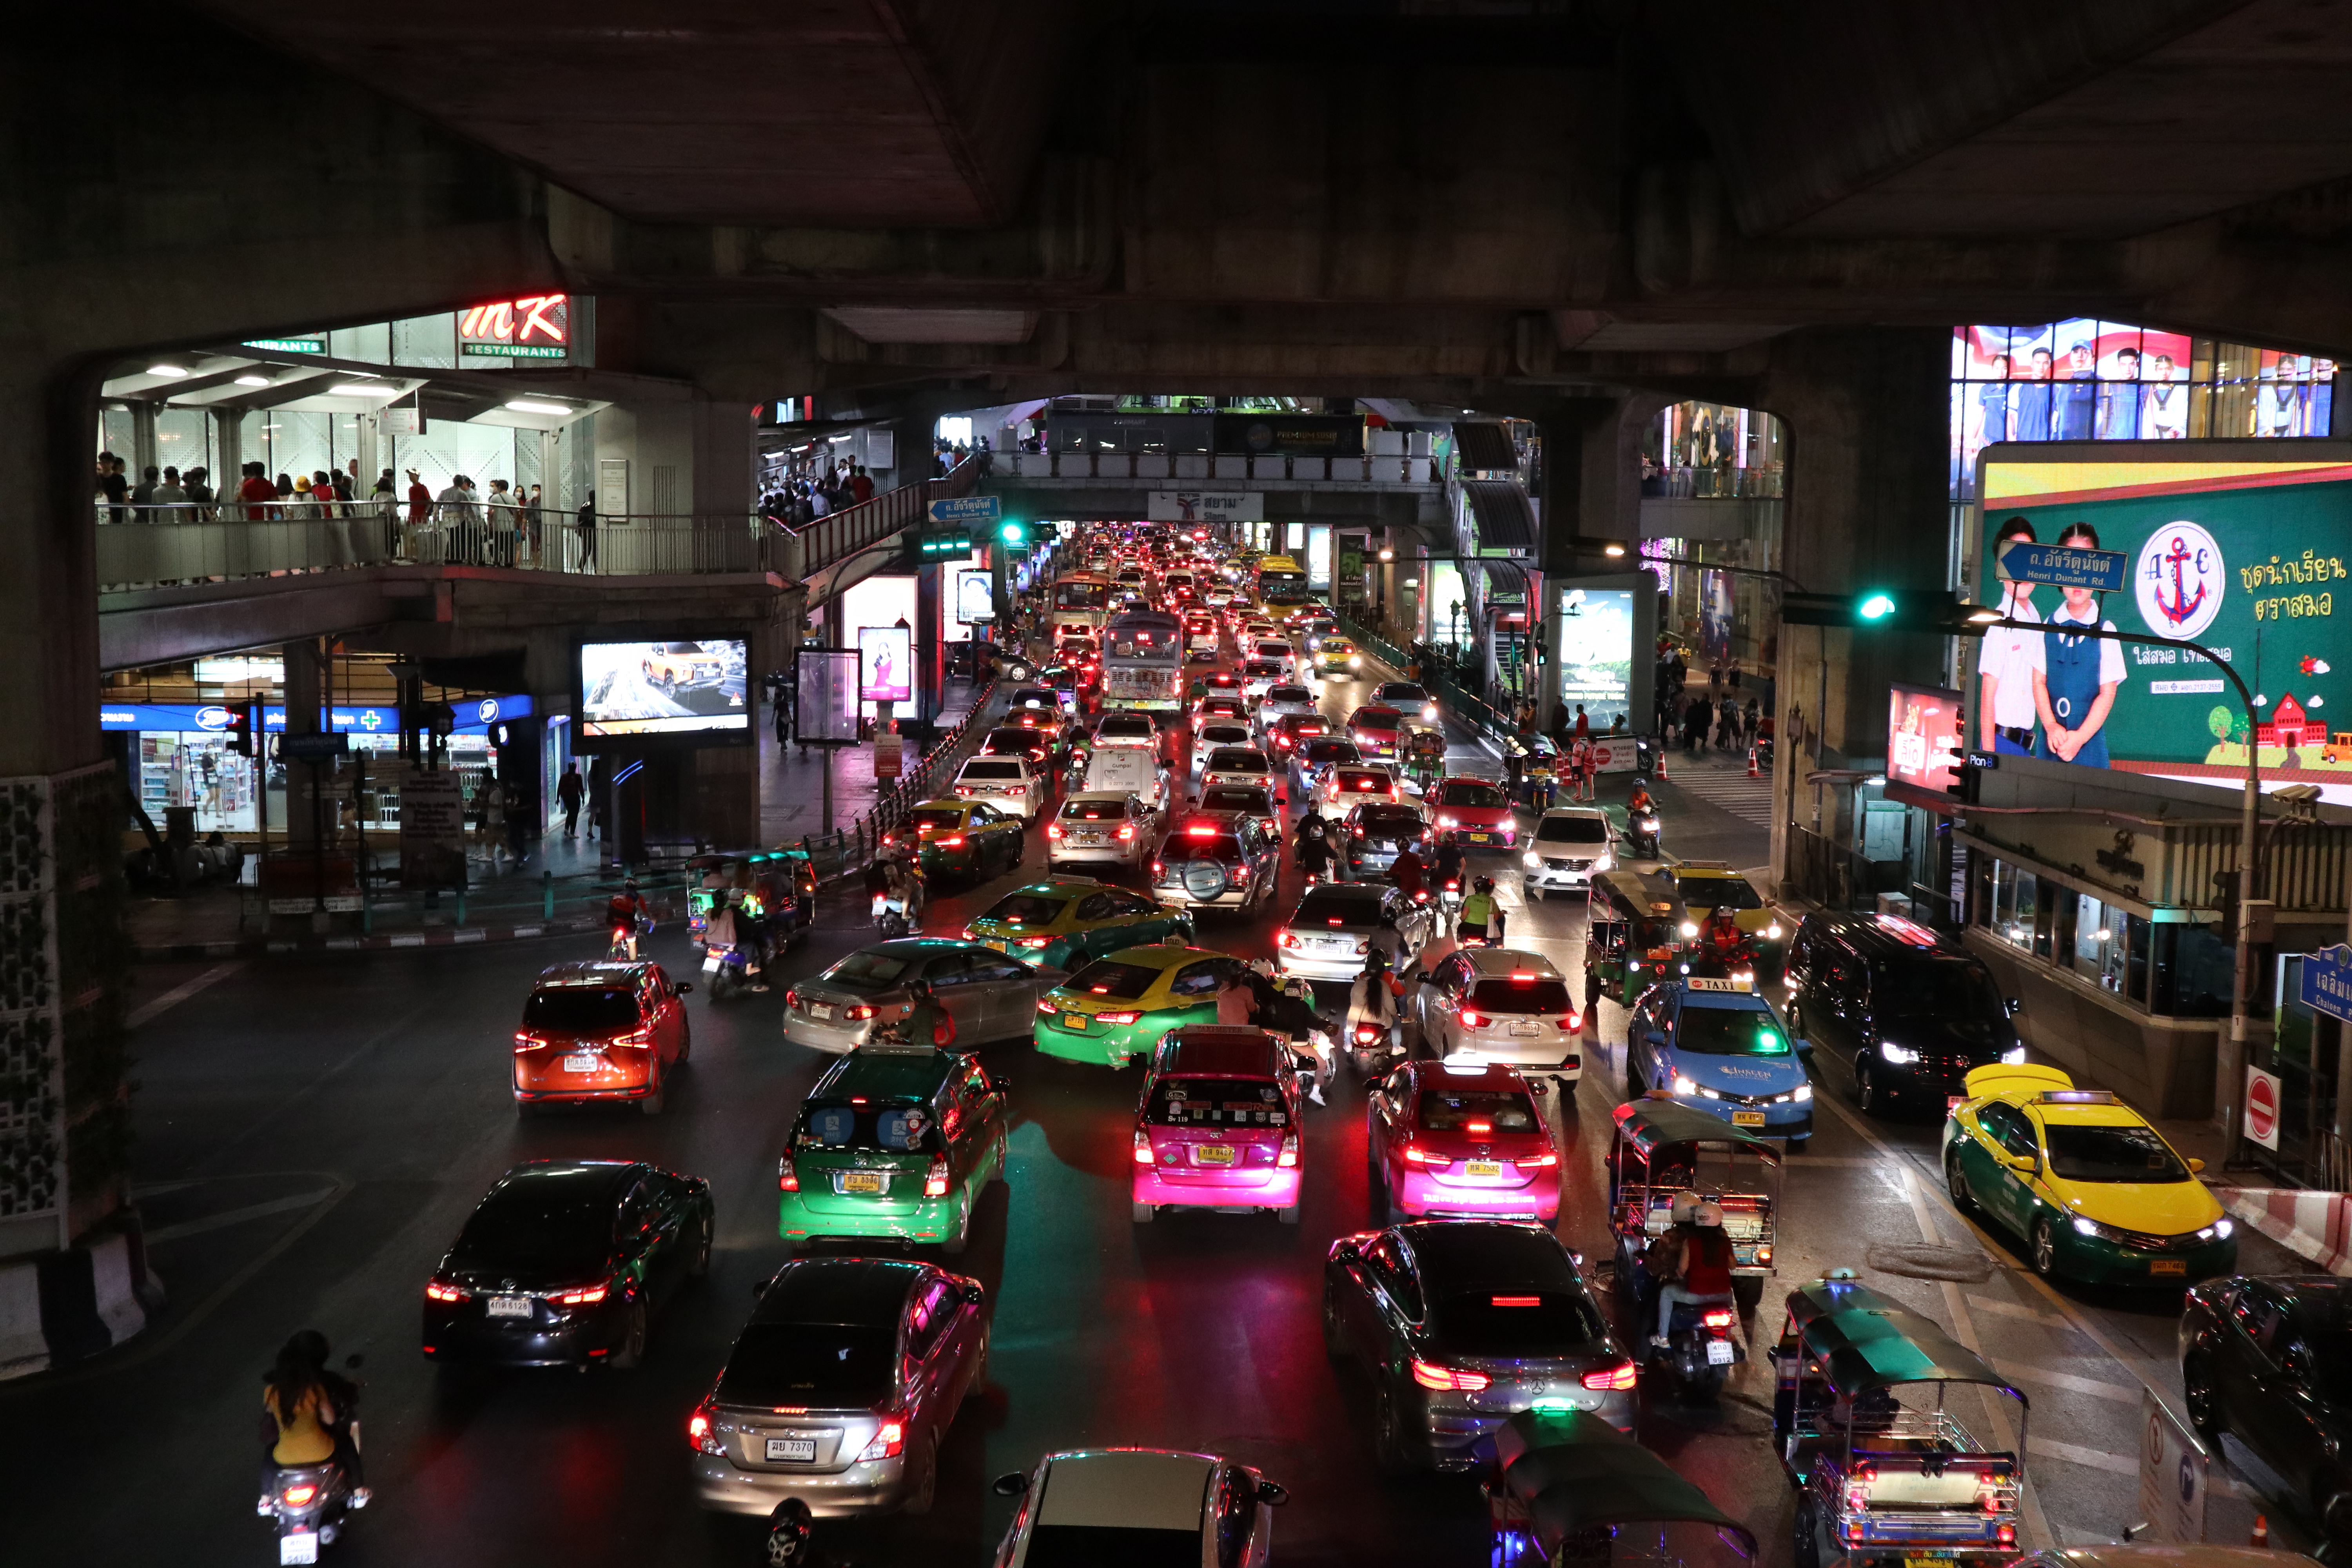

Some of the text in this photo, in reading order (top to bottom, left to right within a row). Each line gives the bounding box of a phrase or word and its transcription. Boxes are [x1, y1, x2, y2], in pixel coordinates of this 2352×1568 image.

[243, 340, 319, 352] AURANTS
[466, 344, 566, 357] RESTAURANTS
[1204, 497, 1236, 508] สยาม
[1204, 512, 1226, 520] Siam
[2031, 549, 2112, 575] ถ. อังรีดูนังต์
[2027, 570, 2106, 586] Henri Dunant Rd.
[2241, 549, 2347, 596] ชุดนักเรียน
[2255, 592, 2332, 621] ตราสมอ
[2133, 646, 2176, 665] ใส่สมอ
[1705, 980, 1735, 990] TAXI
[2316, 971, 2352, 1002] เฉลิมเ
[2316, 995, 2341, 1014] Chaloem
[1423, 1194, 1439, 1203] TAXI
[508, 1302, 527, 1310] 6128
[790, 1442, 812, 1452] 7370
